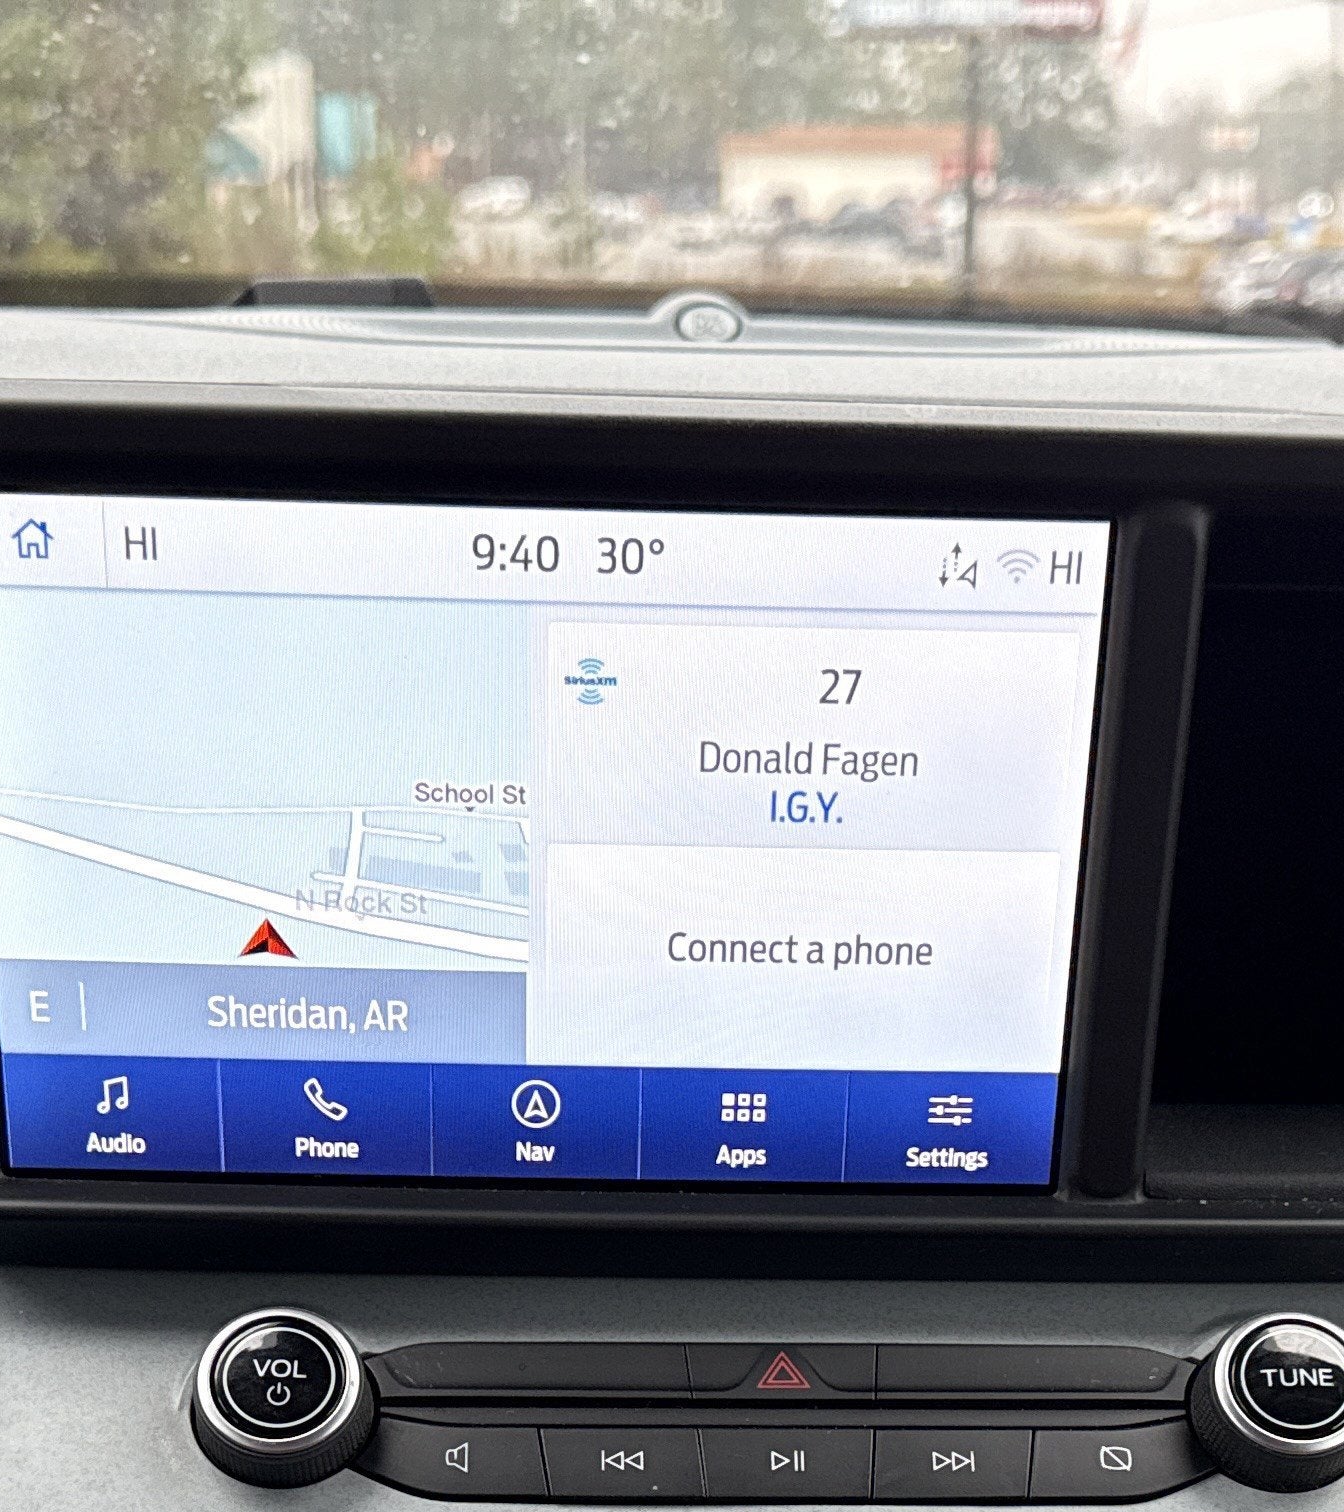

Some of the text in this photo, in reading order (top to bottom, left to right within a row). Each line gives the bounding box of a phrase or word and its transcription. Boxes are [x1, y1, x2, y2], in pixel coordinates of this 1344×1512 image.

[123, 525, 158, 562] HI
[471, 532, 666, 576] 9:40 30°
[1049, 550, 1083, 585] HI
[818, 668, 863, 705] 27
[699, 739, 920, 783] Donald Fagen
[413, 780, 527, 806] School St
[769, 790, 844, 825] I.G.Y.
[295, 888, 428, 915] N Rock St
[666, 931, 934, 972] Connect a phone
[29, 989, 52, 1024] E
[207, 994, 410, 1034] Sheridan, AR
[85, 1131, 147, 1155] Audio
[293, 1135, 361, 1160] Phone
[514, 1140, 556, 1163] Nav
[715, 1144, 768, 1169] Apps
[905, 1146, 990, 1172] Settings
[252, 1358, 308, 1379] VOL
[1259, 1367, 1335, 1388] TUNE
